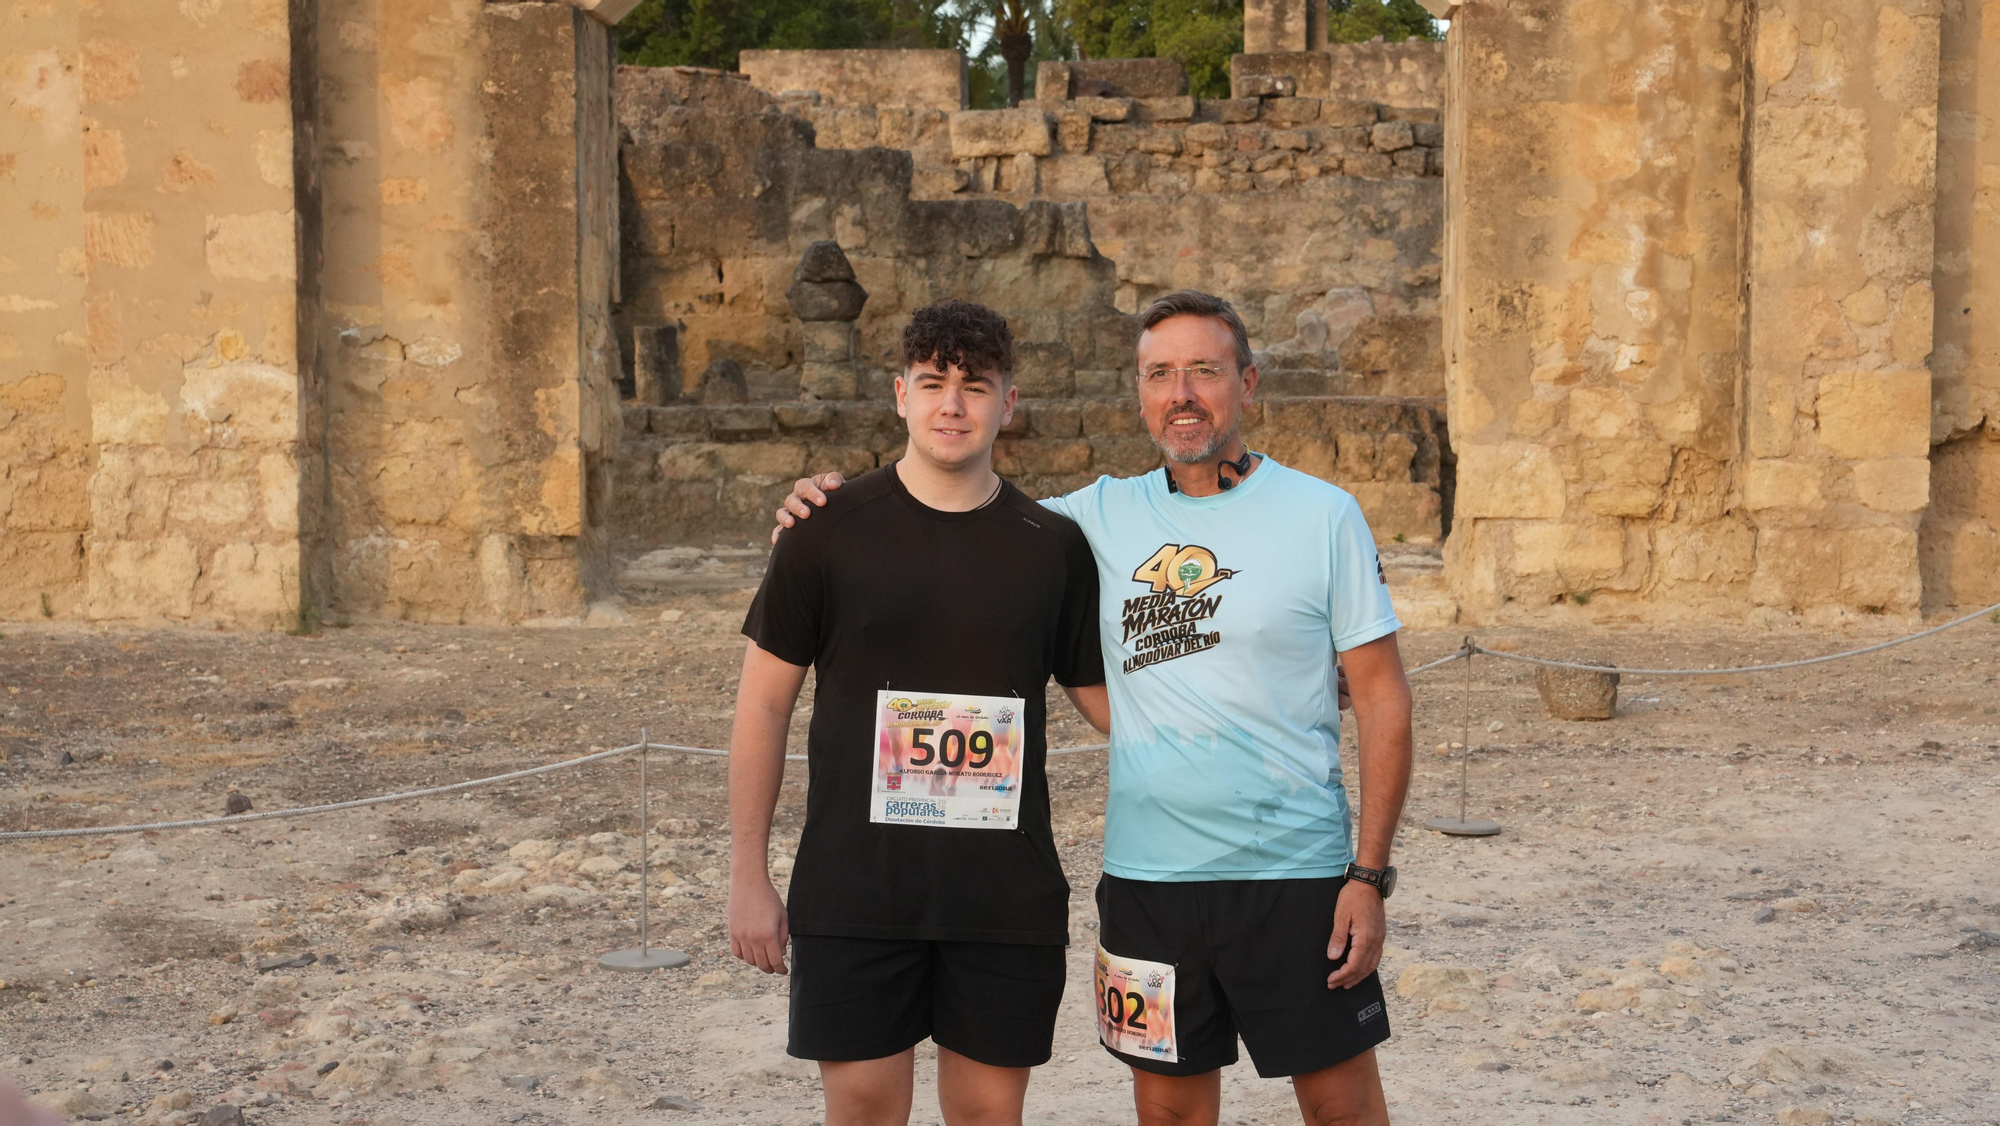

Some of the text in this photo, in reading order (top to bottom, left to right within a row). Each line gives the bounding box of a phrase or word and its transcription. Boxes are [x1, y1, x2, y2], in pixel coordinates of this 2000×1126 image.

[1132, 543, 1222, 598] 40
[1122, 591, 1176, 618] MEDIA
[1121, 592, 1223, 645] MARATÓN
[1123, 630, 1221, 674] ALMODÓVAR DEL RÍO
[886, 698, 913, 712] 40
[910, 728, 994, 769] 509
[979, 784, 1013, 792] serizona
[886, 800, 937, 810] carreras
[886, 806, 946, 817] populares
[885, 816, 914, 824] Diputación
[1099, 978, 1147, 1030] 302
[1139, 1044, 1169, 1054] serizona
